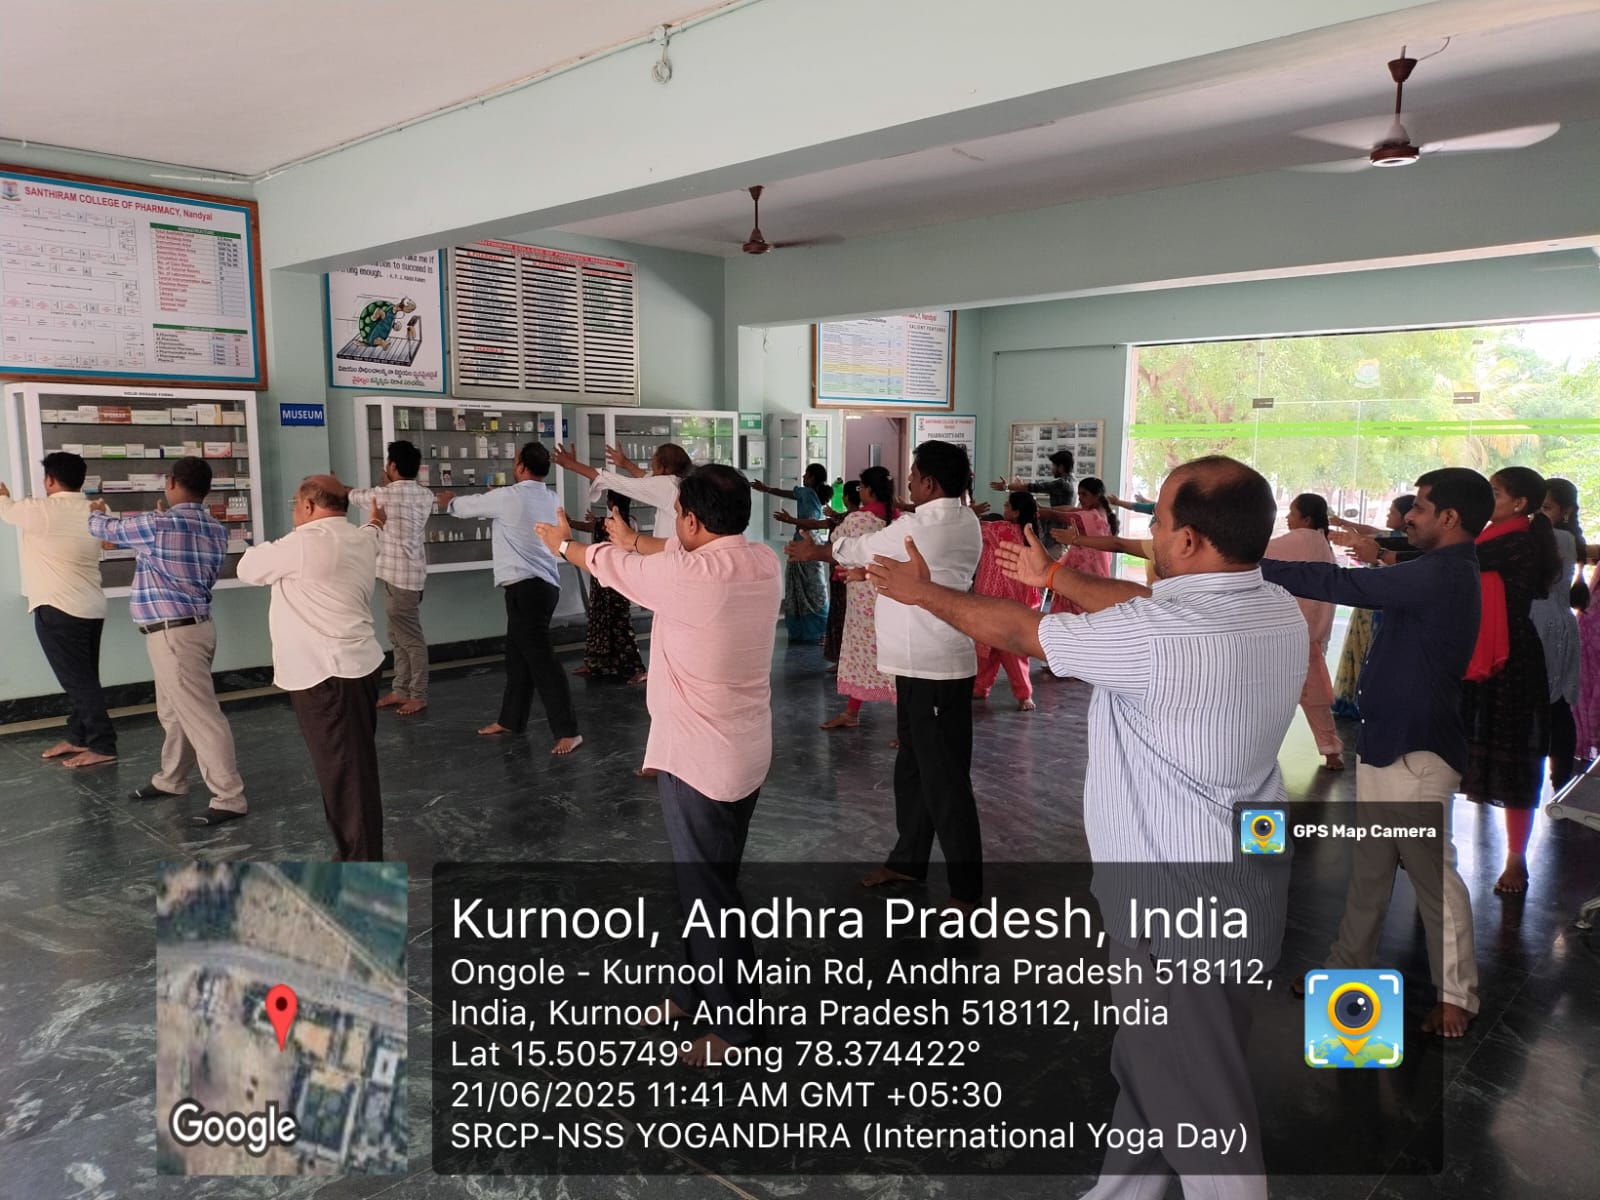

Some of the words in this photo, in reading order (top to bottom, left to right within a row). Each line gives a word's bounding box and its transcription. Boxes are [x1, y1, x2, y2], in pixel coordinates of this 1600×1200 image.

[24, 186, 77, 201] SANTHIRAM
[79, 194, 119, 208] COLLEGE
[121, 200, 133, 209] OF
[135, 202, 182, 217] PHARMACY,
[183, 210, 213, 222] Nandyal
[393, 261, 401, 270] to
[282, 409, 323, 420] MUSEUM
